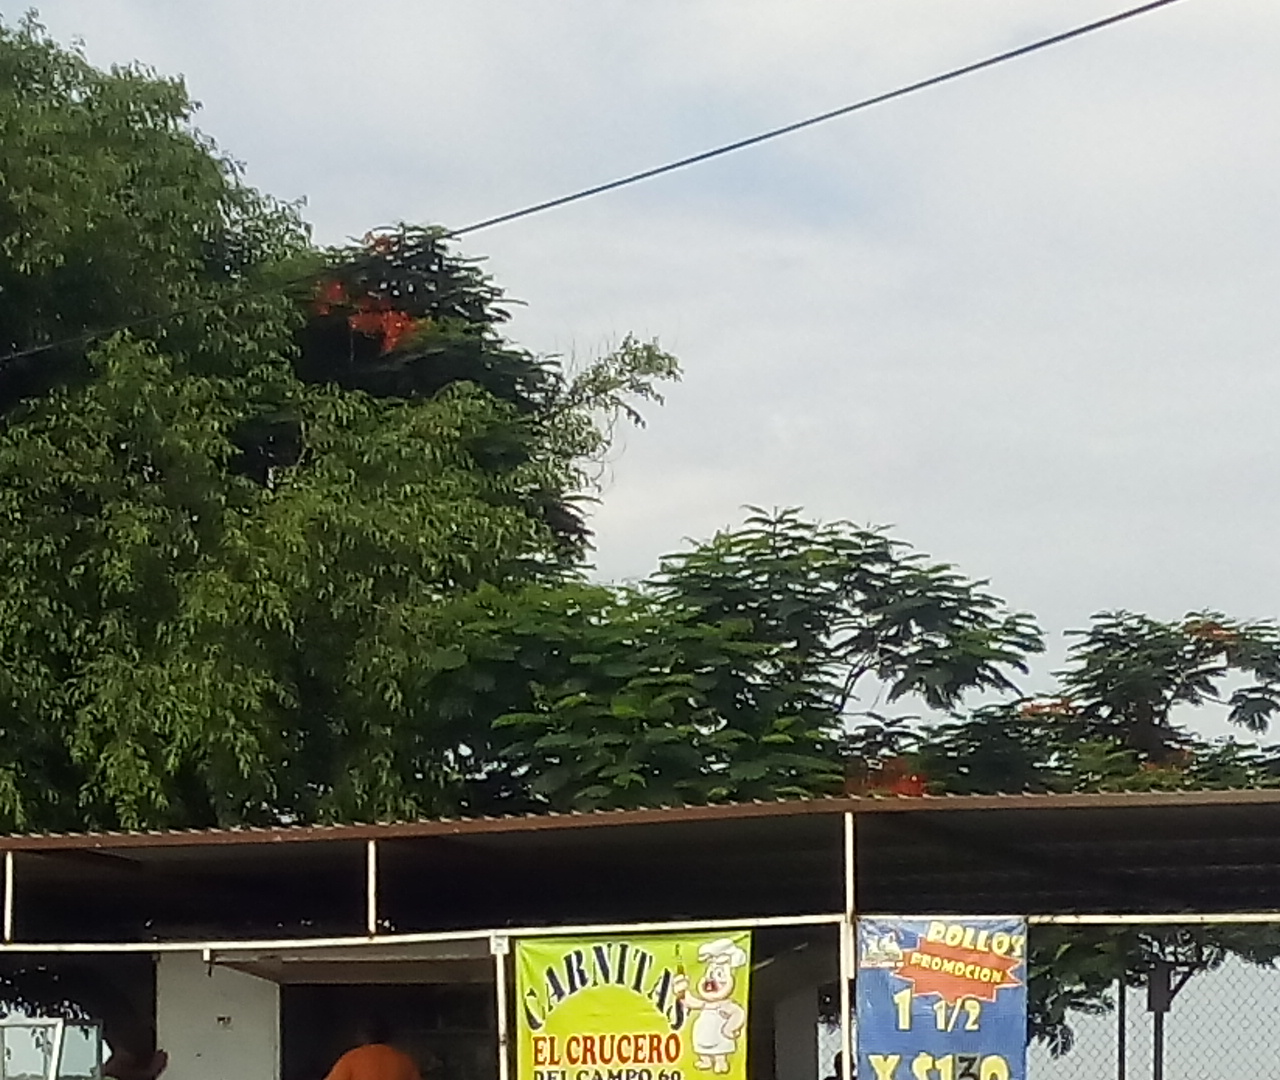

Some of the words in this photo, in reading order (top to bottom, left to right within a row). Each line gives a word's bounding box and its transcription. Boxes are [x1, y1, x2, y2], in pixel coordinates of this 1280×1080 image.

[911, 952, 1003, 983] PROMOCION
[523, 943, 692, 1031] CARNITAS
[894, 988, 912, 1030] 1
[933, 999, 981, 1032] 1/2
[532, 1036, 561, 1066] EL
[566, 1033, 682, 1066] CRUCERO
